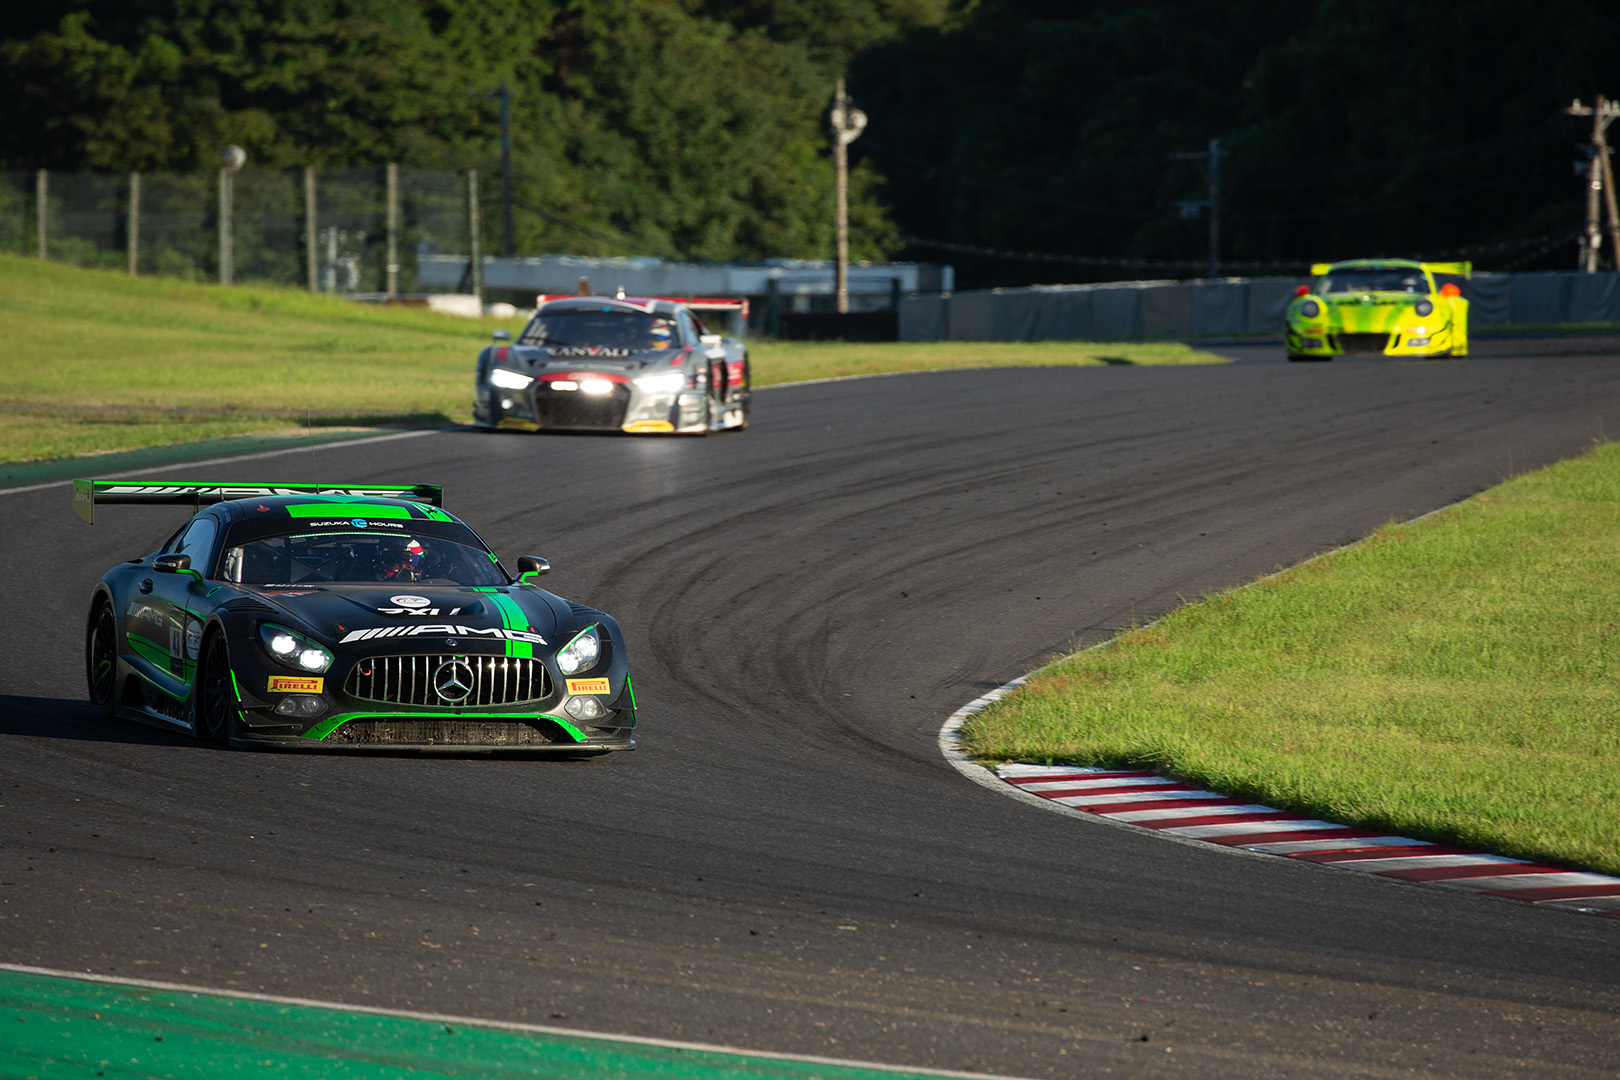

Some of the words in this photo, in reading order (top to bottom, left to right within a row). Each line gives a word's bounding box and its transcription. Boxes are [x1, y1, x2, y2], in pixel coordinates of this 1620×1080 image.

[351, 519, 368, 528] 10
[407, 624, 548, 645] AMG
[272, 679, 318, 690] PIRELLI
[571, 680, 606, 691] PIRELLI
